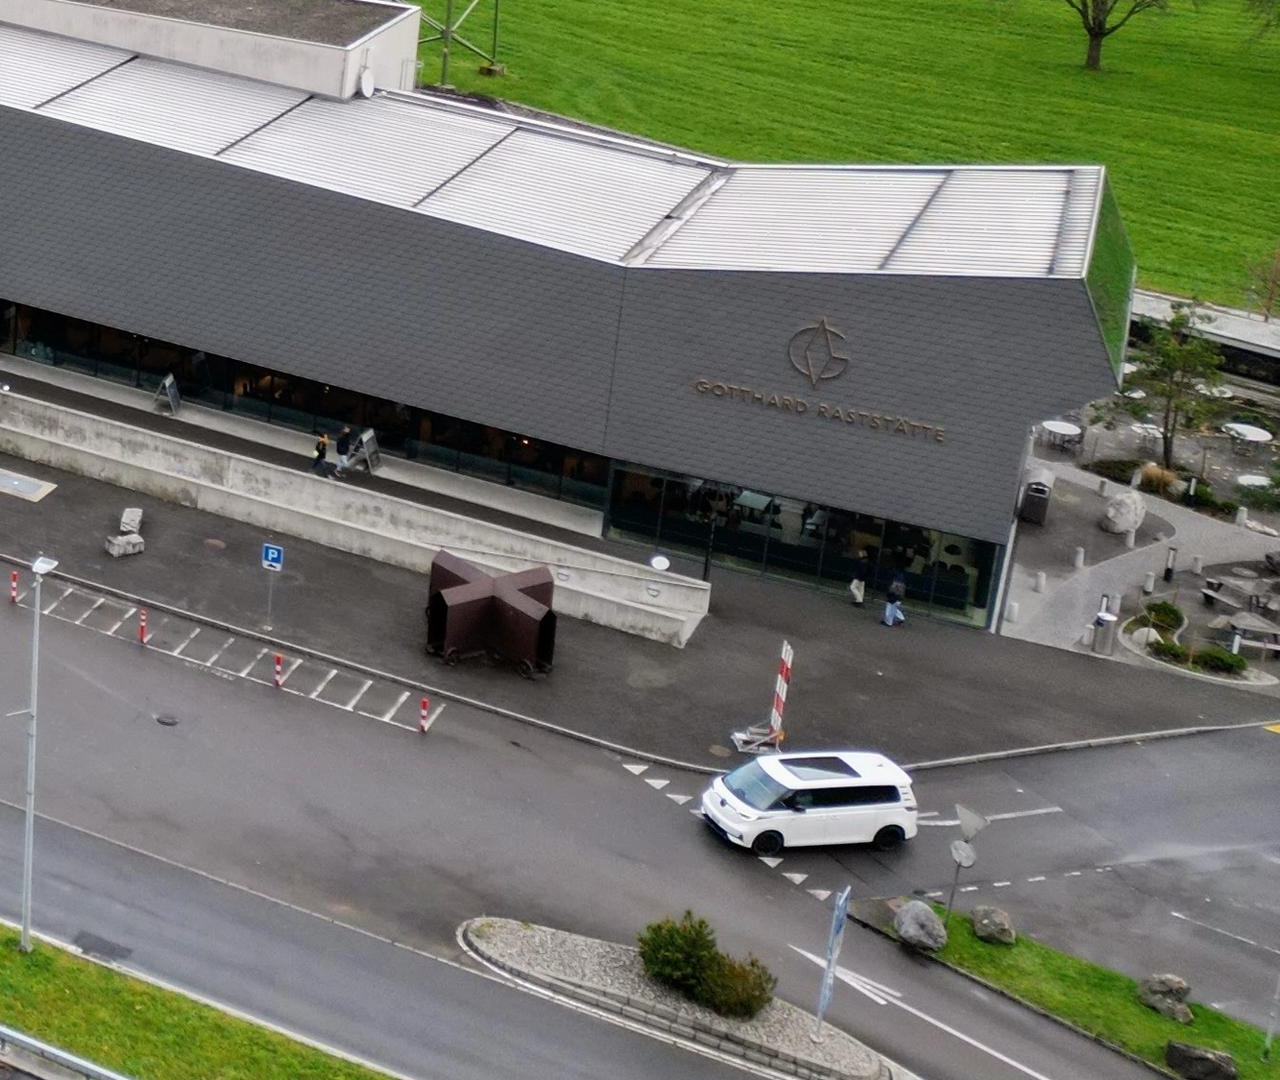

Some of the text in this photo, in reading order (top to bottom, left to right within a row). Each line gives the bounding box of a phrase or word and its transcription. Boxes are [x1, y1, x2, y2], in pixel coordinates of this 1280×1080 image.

[695, 378, 946, 443] GOTTHARD RASTSTÄTTE
[268, 549, 278, 561] P
